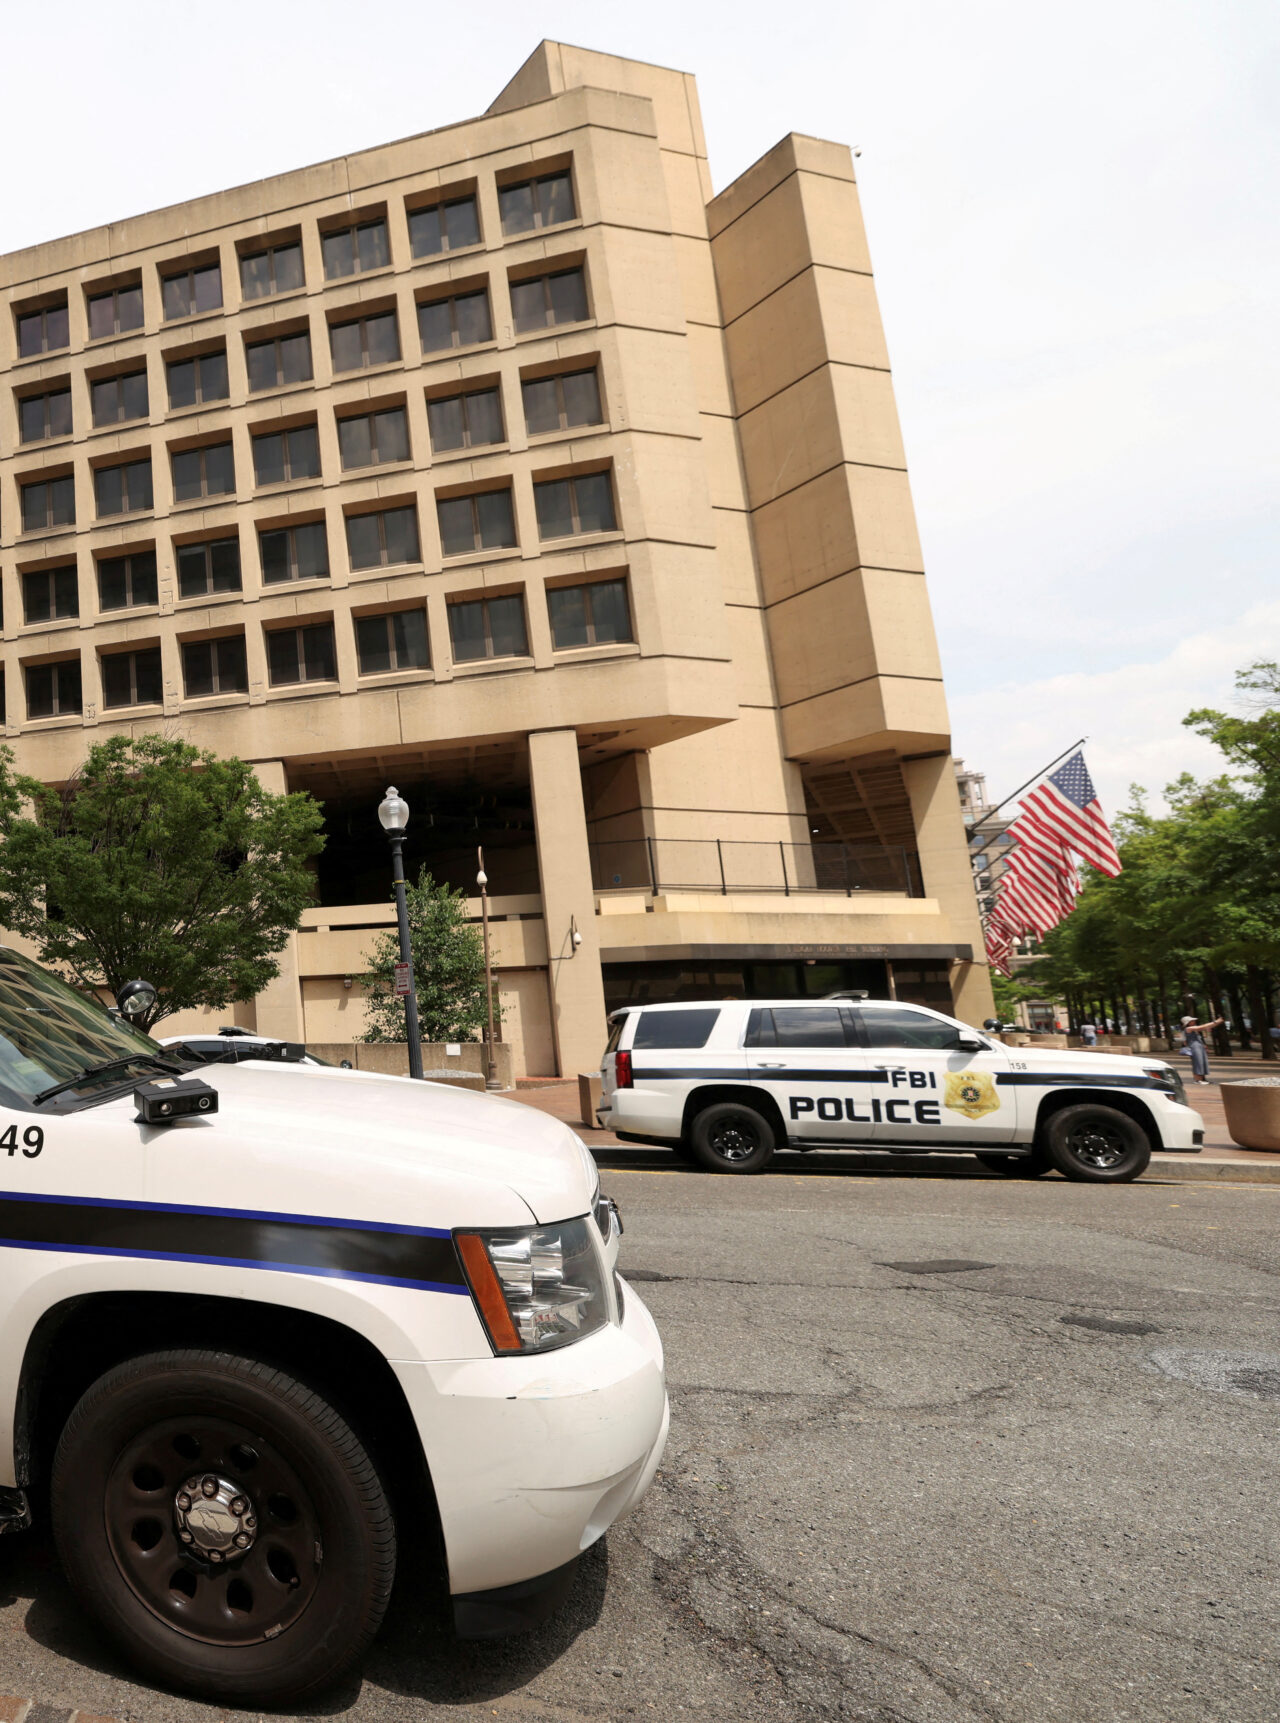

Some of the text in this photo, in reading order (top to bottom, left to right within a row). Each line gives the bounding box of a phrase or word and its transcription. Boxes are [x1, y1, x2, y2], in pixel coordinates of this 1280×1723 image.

[1010, 1062, 1027, 1070] 158
[891, 1070, 937, 1089] FBI
[789, 1096, 942, 1125] POLICE
